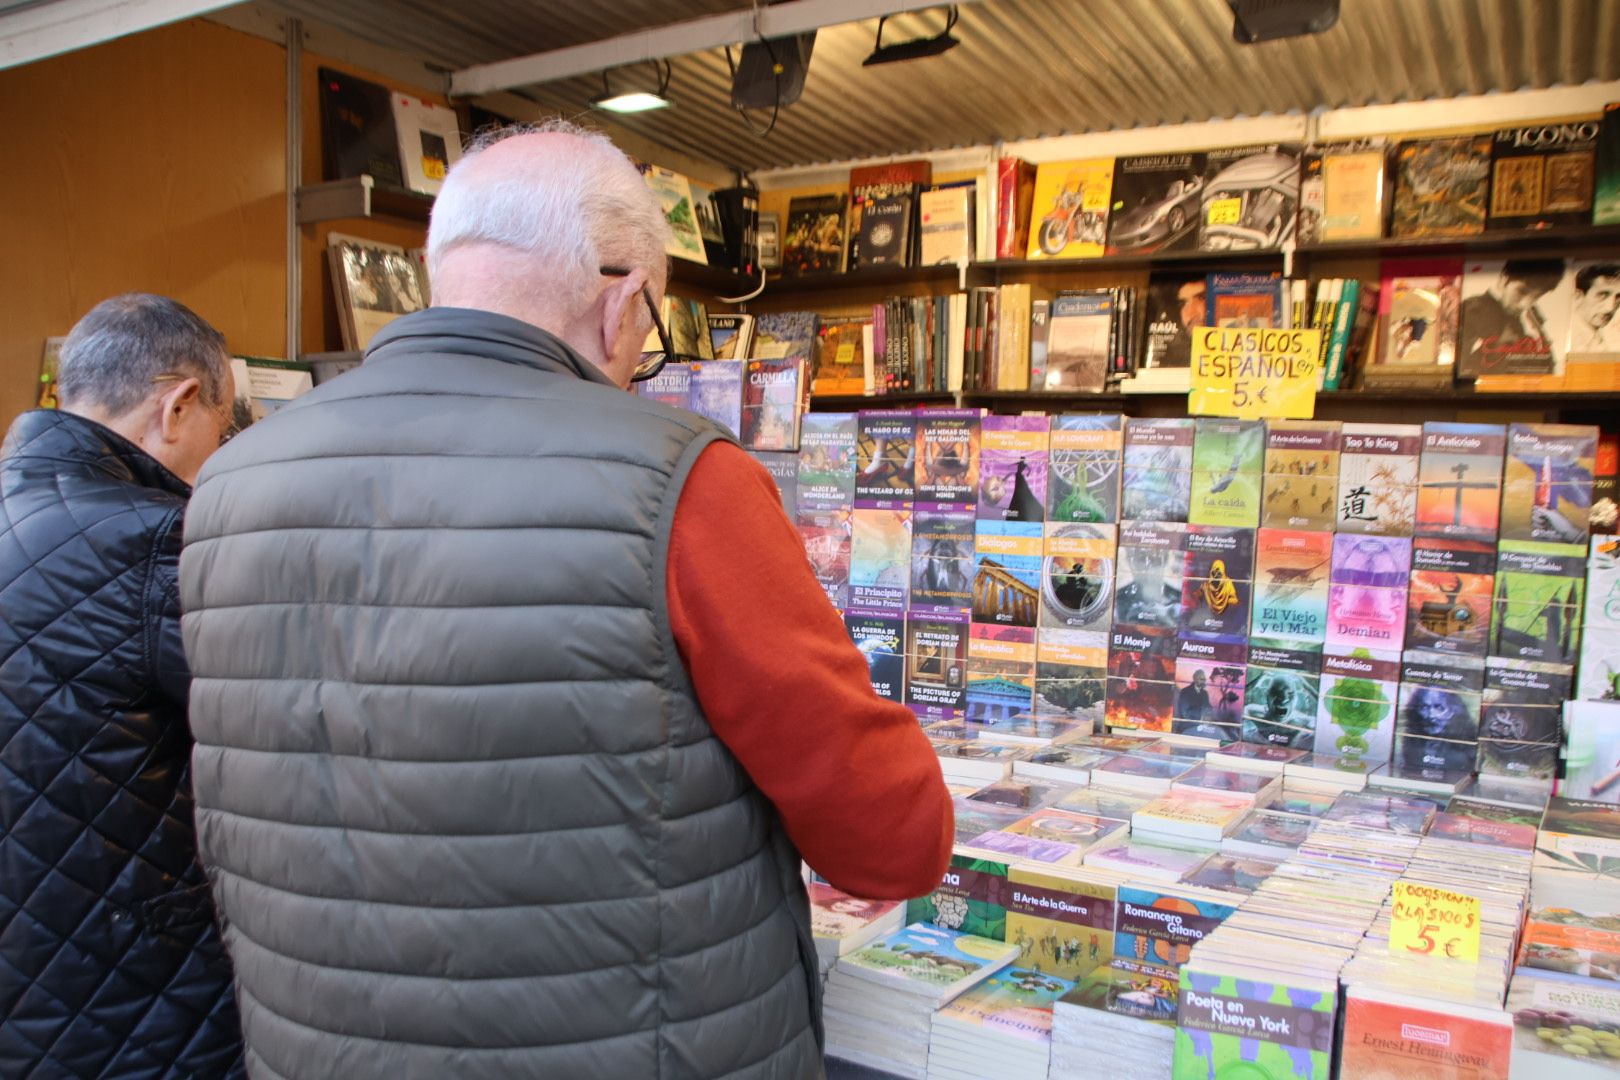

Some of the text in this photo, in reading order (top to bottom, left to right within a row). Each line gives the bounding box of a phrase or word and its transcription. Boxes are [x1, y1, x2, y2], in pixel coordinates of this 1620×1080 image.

[1197, 351, 1300, 379] ESPAÑOL
[750, 372, 796, 387] CARMILLA
[924, 428, 936, 436] LAS
[1346, 437, 1399, 450] Tao Te King
[1427, 435, 1481, 449] El Anticristo
[803, 492, 846, 500] WONDERLAND
[857, 487, 914, 496] THE WIZARD OF OZ
[1340, 485, 1379, 522] 道
[855, 587, 903, 600] El Principito
[852, 597, 903, 609] The Little Prince
[1262, 607, 1317, 625] El Viejo
[852, 626, 896, 635] LA GUERRA DE
[1259, 620, 1318, 636] y el Mar
[1336, 623, 1391, 640] Demian
[853, 632, 894, 641] LOS MUNDOS
[915, 632, 960, 642] EL RETRATO DE
[1114, 634, 1122, 645] El
[1123, 635, 1152, 649] Monje
[917, 639, 958, 649] DORIAN GRAY
[1182, 641, 1215, 655] Aurora
[1326, 657, 1373, 673] Metafísica
[1405, 668, 1431, 678] Cuentos
[910, 686, 961, 697] THE PICTURE OF
[913, 694, 957, 705] DORIAN GRAY
[1013, 892, 1088, 915] El Arte de la Guerra
[1124, 903, 1183, 925] Romancero
[1166, 922, 1203, 940] Gitano
[1186, 992, 1244, 1013] Poeta en
[1211, 1009, 1290, 1036] Nueva York
[1362, 1031, 1405, 1048] Ernest
[1408, 1041, 1490, 1068] Hemingway
